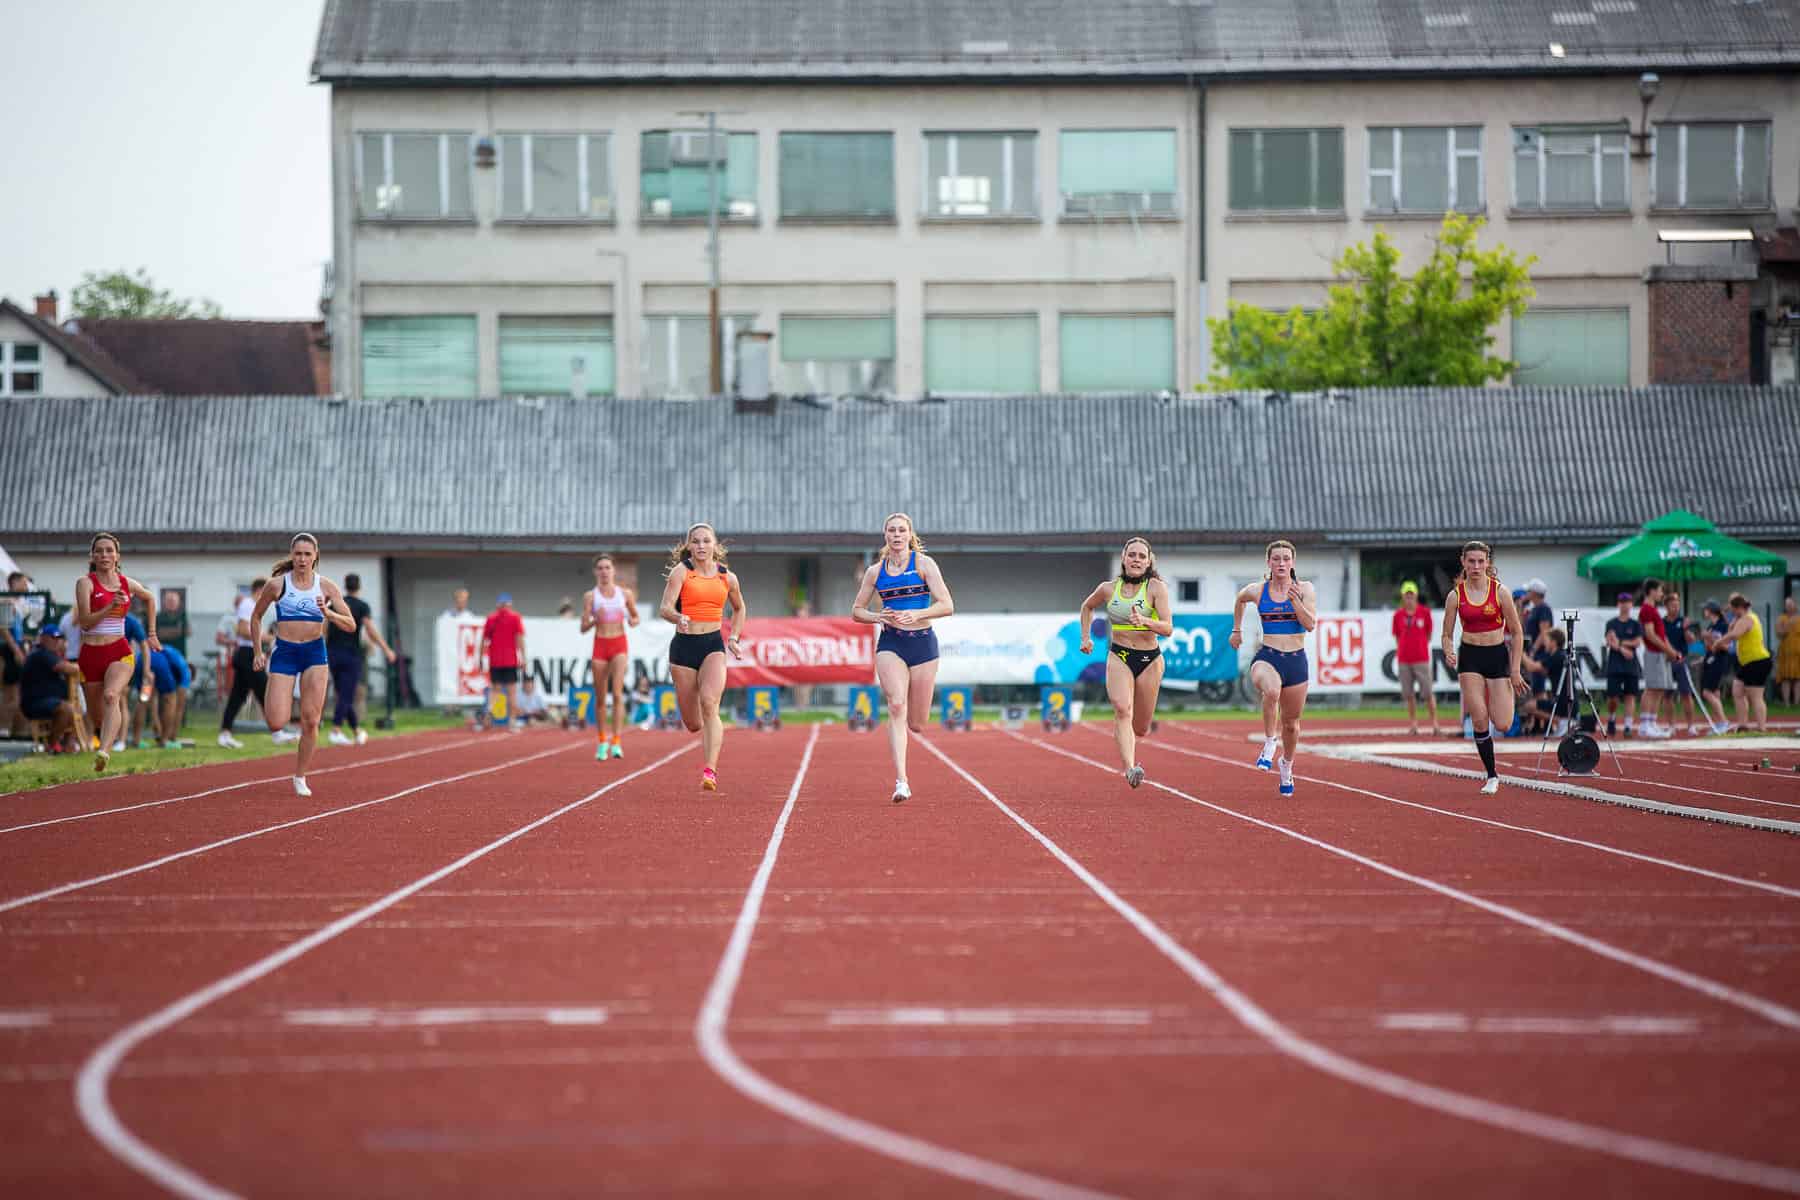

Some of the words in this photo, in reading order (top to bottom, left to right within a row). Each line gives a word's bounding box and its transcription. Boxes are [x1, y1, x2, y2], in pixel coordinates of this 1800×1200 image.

[1321, 621, 1362, 664] CC
[575, 692, 592, 721] 7
[754, 691, 771, 718] 5
[855, 691, 872, 719] 4
[1048, 692, 1065, 719] 2
